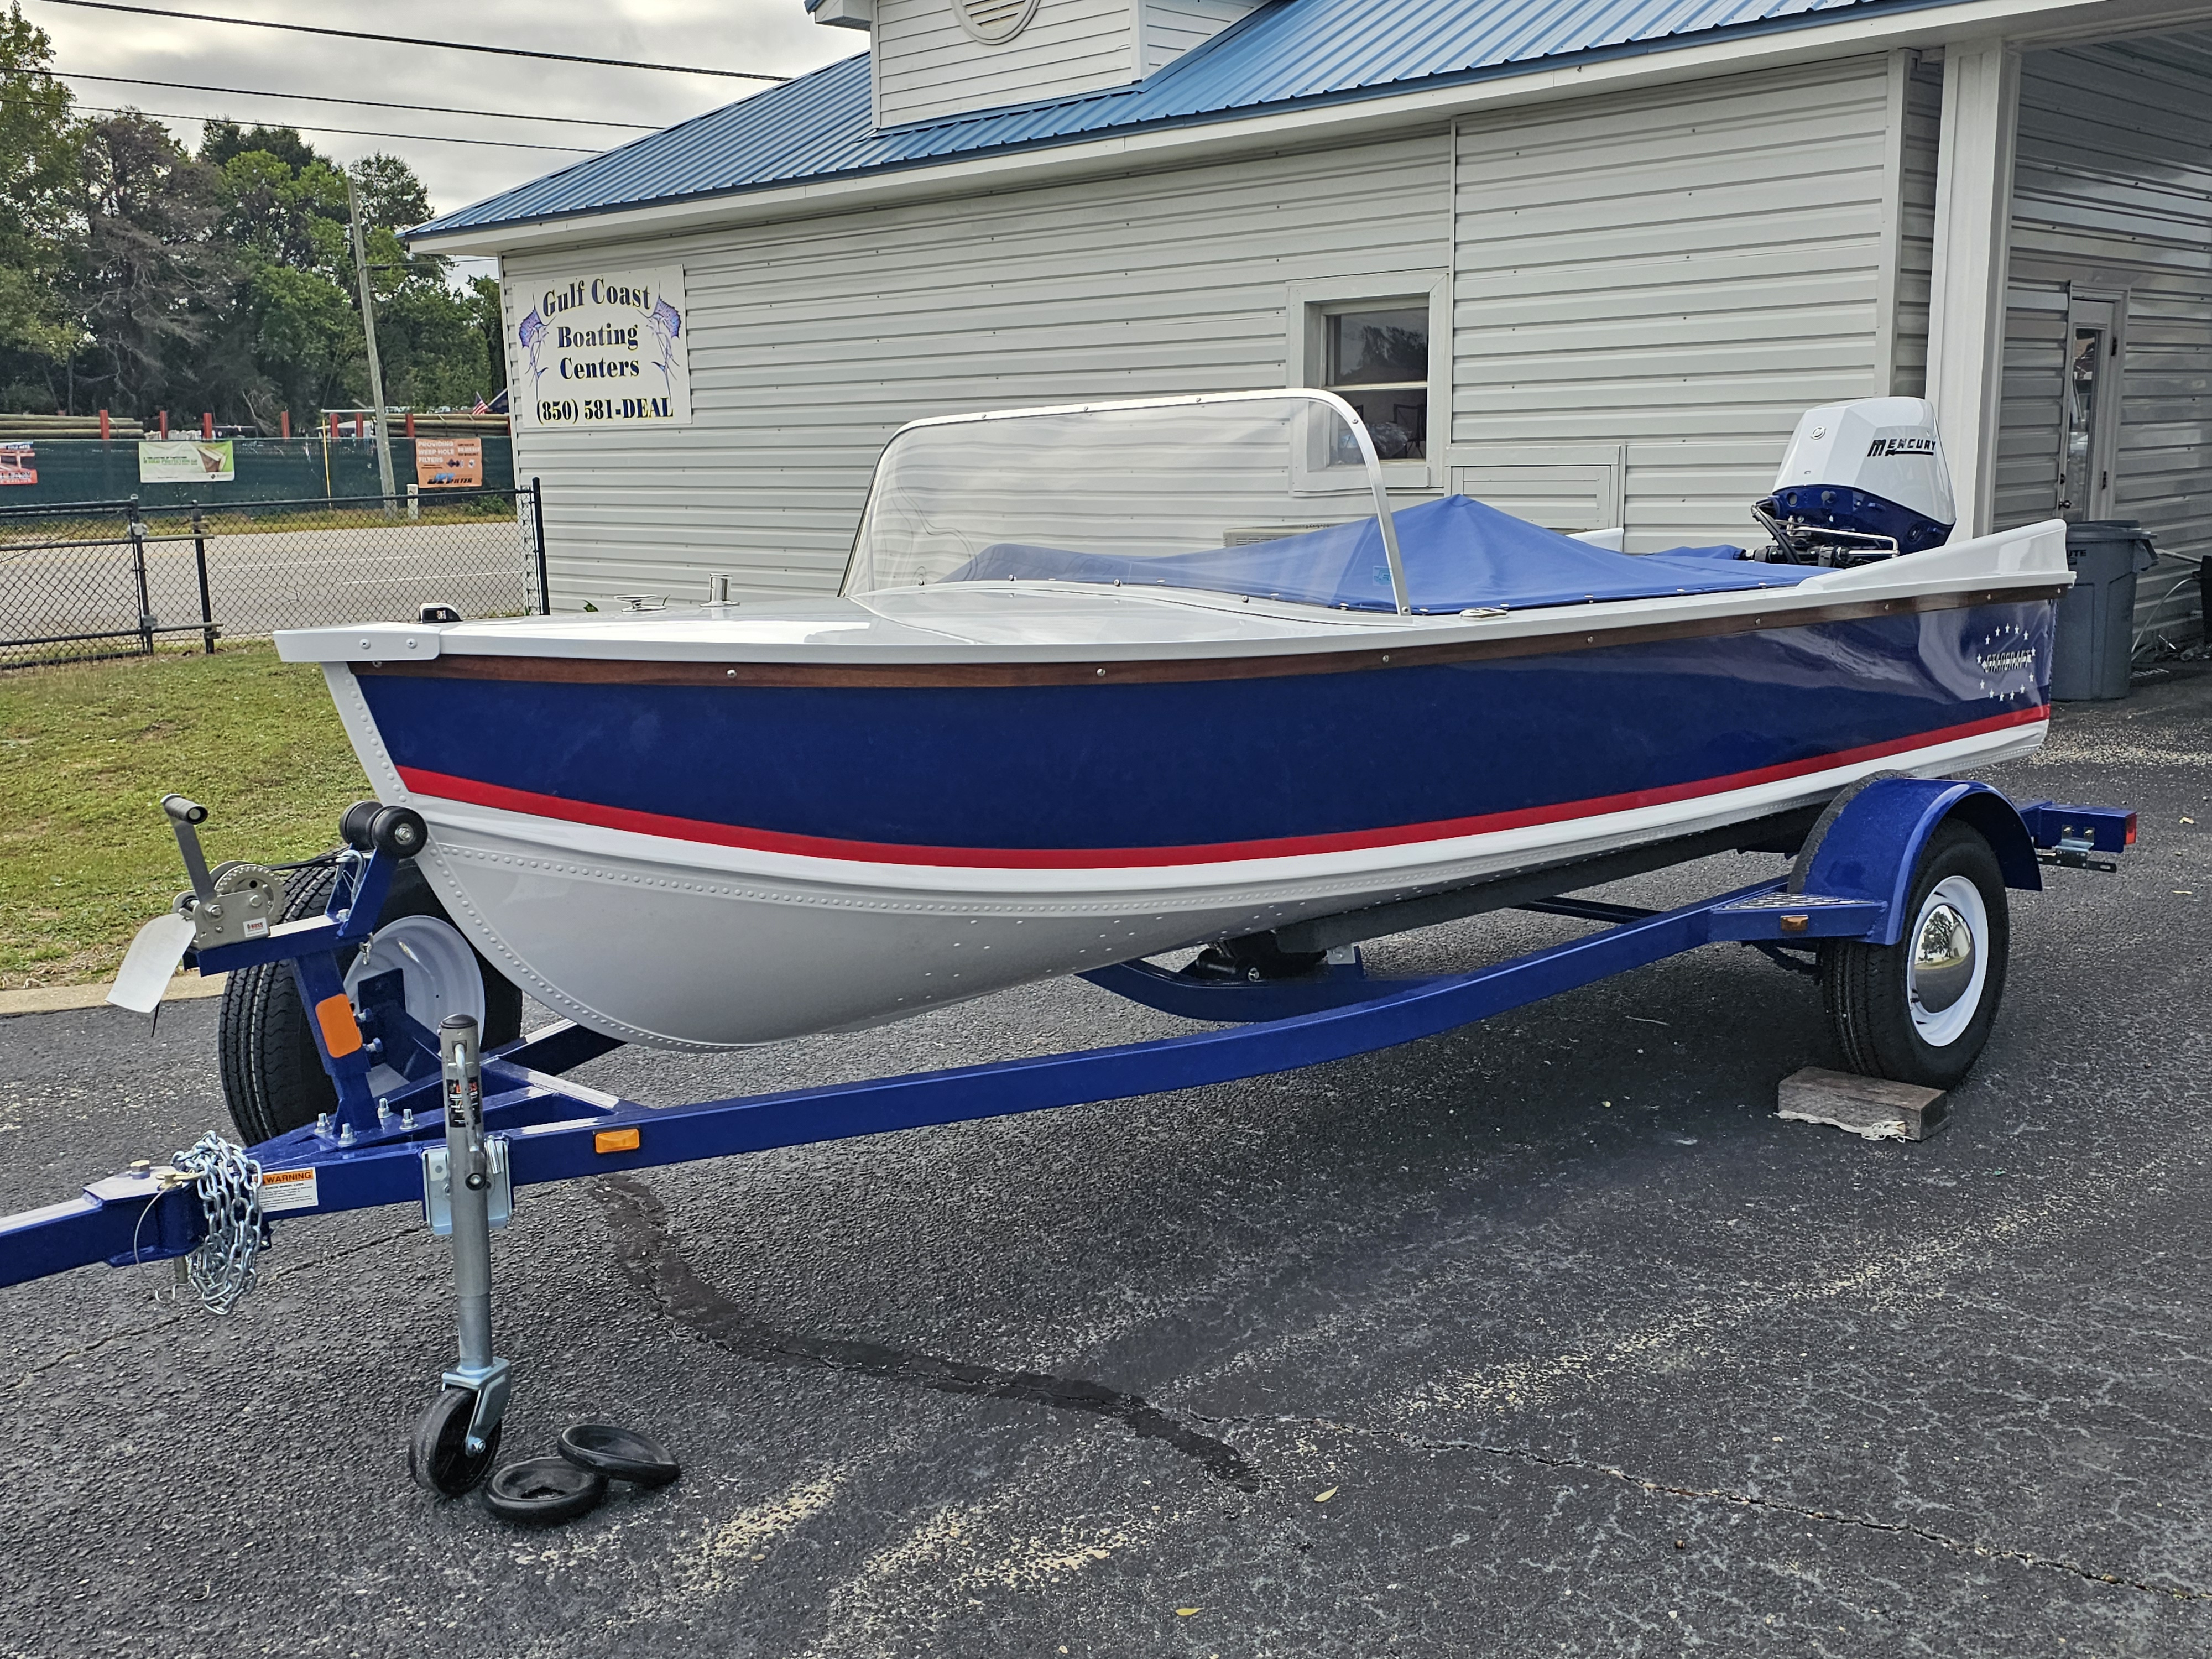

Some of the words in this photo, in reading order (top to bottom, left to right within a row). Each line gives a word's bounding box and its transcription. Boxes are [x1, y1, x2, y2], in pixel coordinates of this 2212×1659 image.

[543, 280, 585, 317] Gulf
[591, 278, 651, 310] Coast
[557, 322, 638, 351] Boating
[560, 357, 639, 379] Centers
[536, 398, 578, 425] (850)
[584, 397, 674, 420] 581-DEAL
[1867, 439, 1936, 457] MERCURY
[265, 1171, 311, 1183] WARNING
